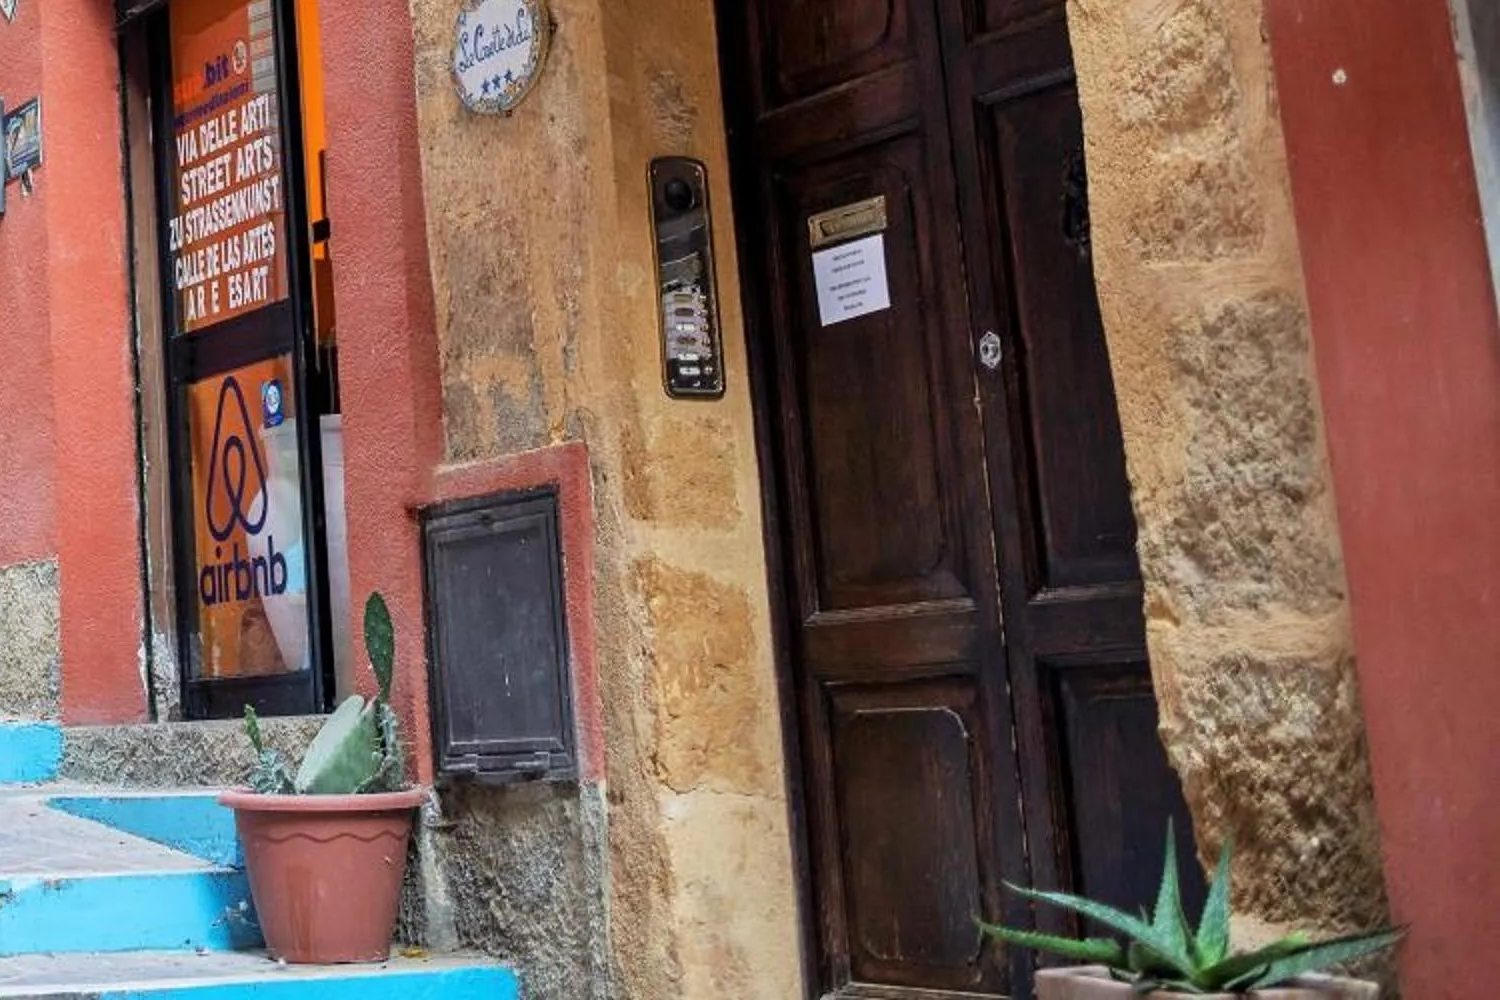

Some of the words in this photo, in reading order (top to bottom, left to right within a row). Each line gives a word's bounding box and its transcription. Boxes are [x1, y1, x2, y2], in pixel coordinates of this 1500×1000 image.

[176, 129, 199, 167] VIA
[199, 109, 238, 156] DELLE
[239, 93, 268, 138] ARTI
[181, 151, 232, 205] STREET
[235, 135, 273, 183] ARTS
[175, 249, 205, 291] CALLE
[221, 235, 240, 272] LAS
[243, 221, 275, 264] ARTES
[200, 534, 288, 606] airbnb
